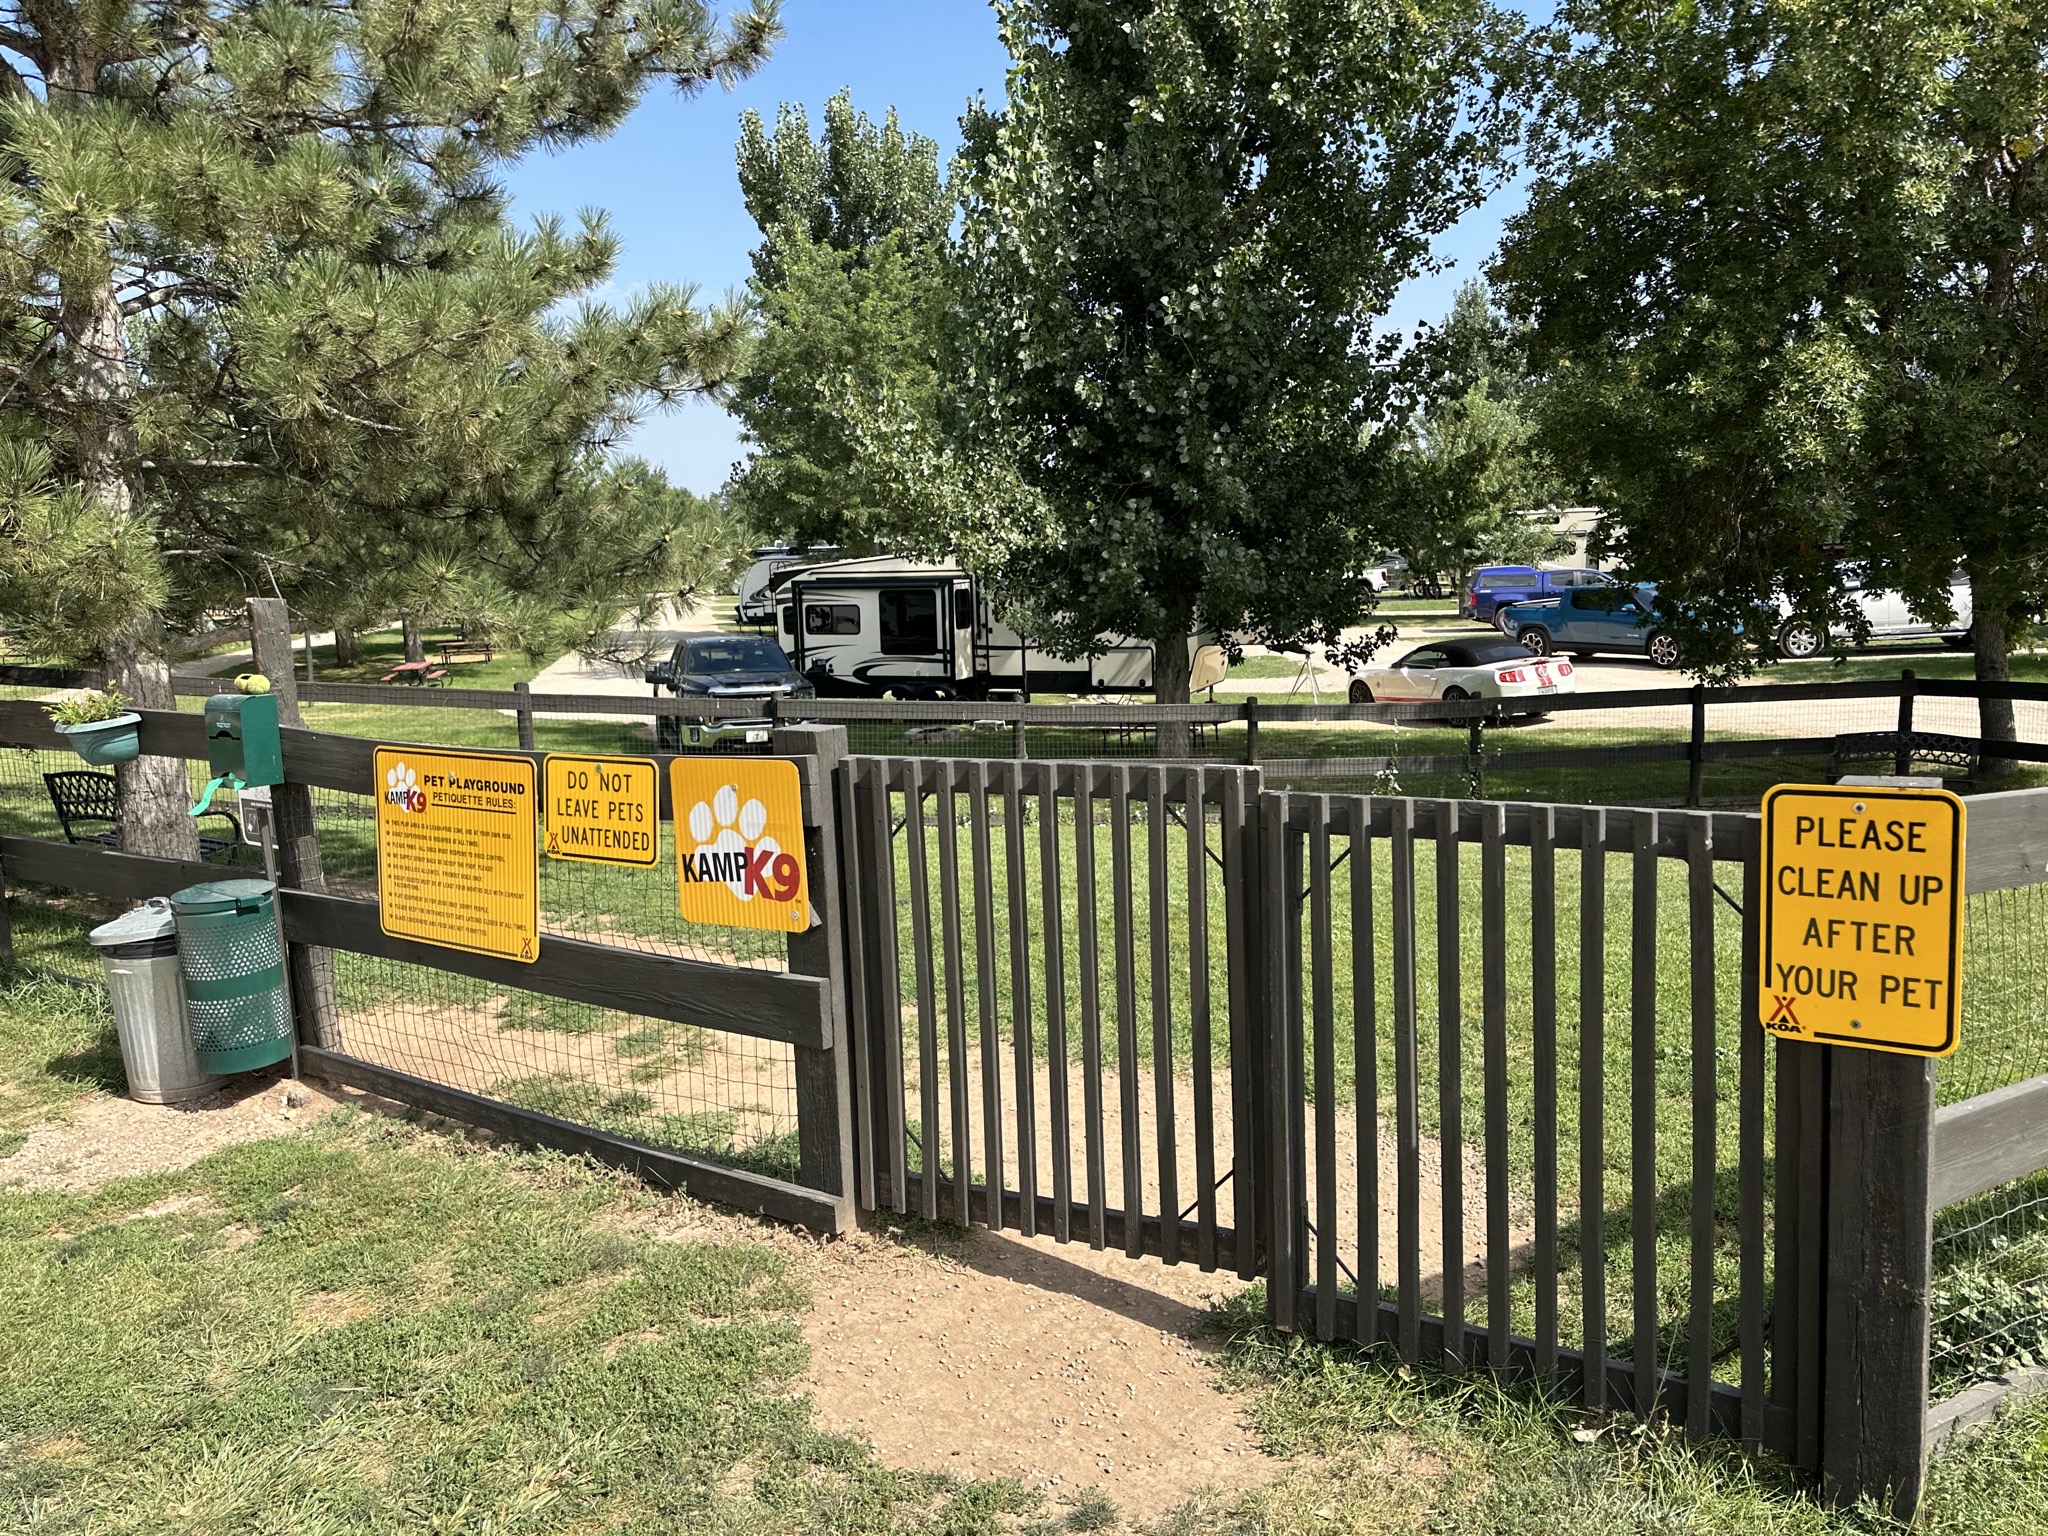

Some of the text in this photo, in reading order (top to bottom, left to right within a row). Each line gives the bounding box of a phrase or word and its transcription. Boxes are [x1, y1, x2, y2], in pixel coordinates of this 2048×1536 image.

[424, 776, 525, 795] PET PLAYGROUND
[568, 771, 632, 793] DO NOT
[433, 792, 516, 809] PETIQUETTE RULES:
[558, 798, 643, 822] LEAVE PETS
[562, 826, 649, 851] UNATTENDED
[1796, 816, 1927, 852] PLEASE
[1778, 866, 1943, 906] CLEAN UP
[1803, 918, 1916, 956] AFTER
[1776, 963, 1942, 1010] YOUR PET
[1766, 1022, 1802, 1034] KOA
